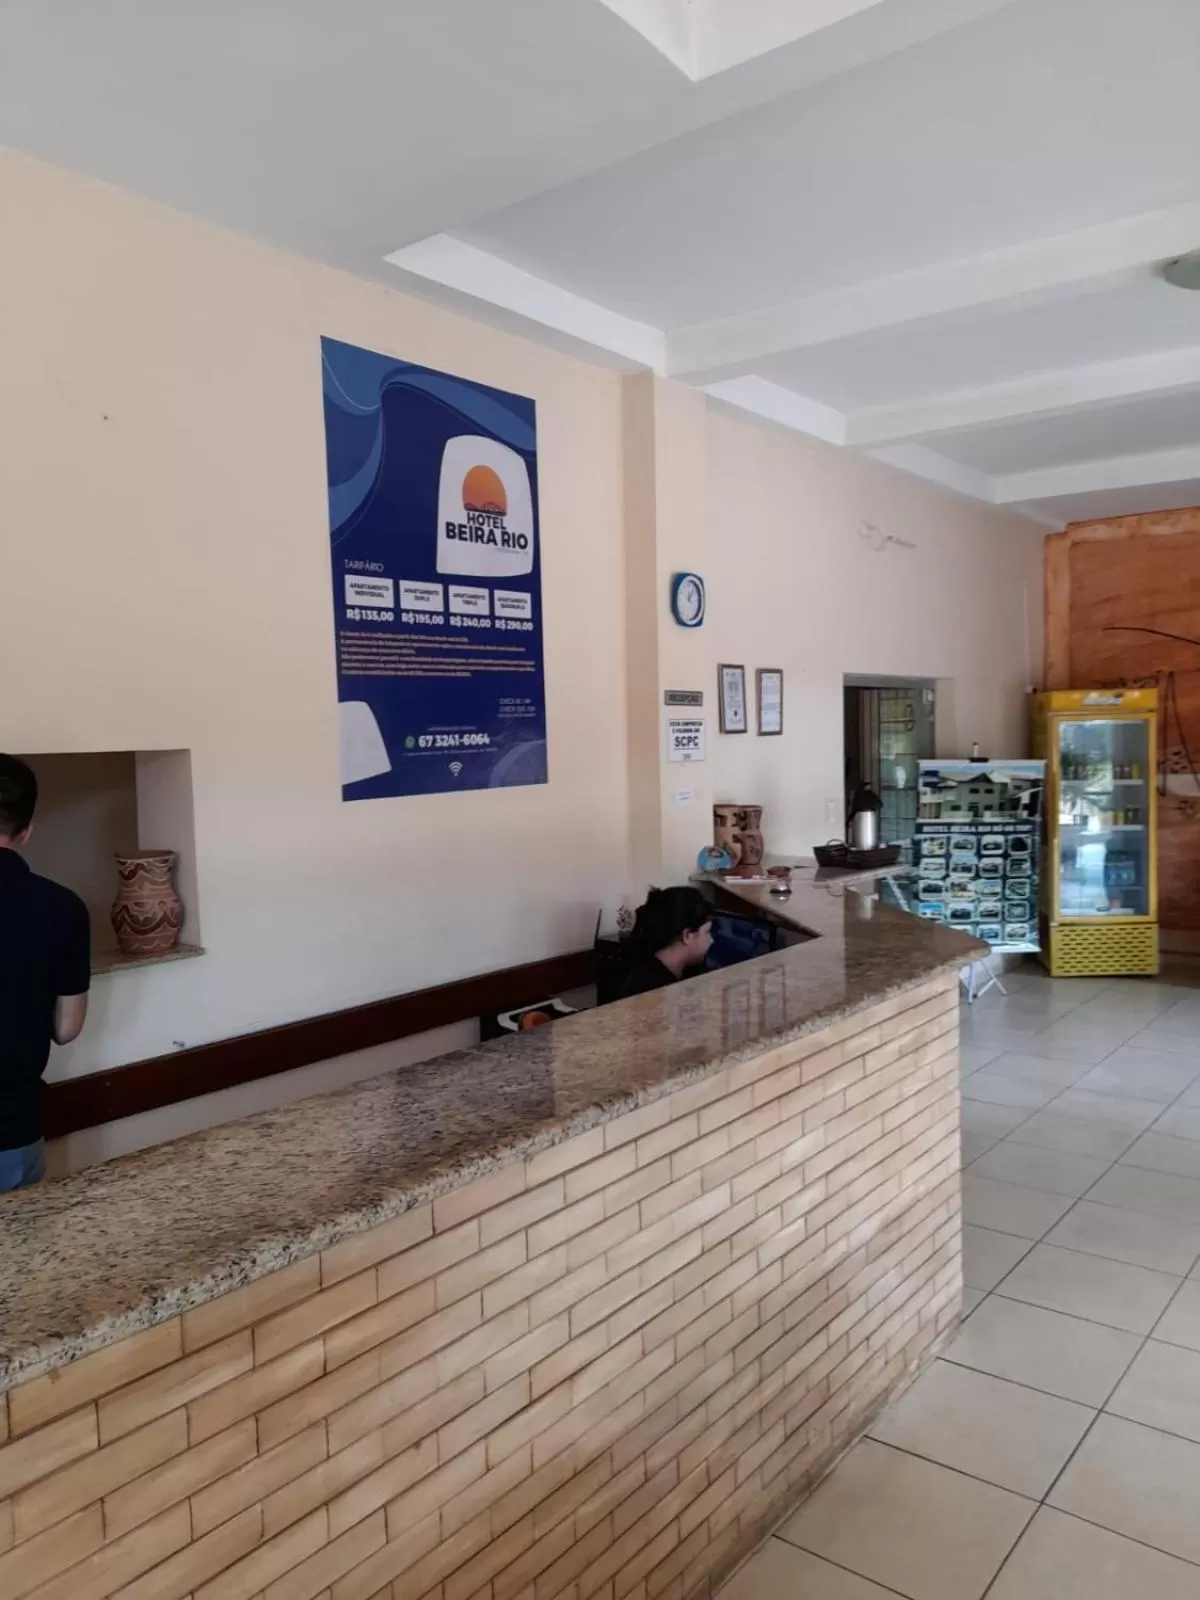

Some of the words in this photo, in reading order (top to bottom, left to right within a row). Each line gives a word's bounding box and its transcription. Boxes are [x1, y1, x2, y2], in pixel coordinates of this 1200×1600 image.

[466, 512, 507, 530] HOTEL
[445, 521, 498, 546] BEIRA
[501, 530, 528, 550] RIO
[344, 558, 384, 573] TARIFÁRIO
[418, 735, 433, 748] 67
[434, 733, 490, 746] 3241-6064
[674, 736, 699, 748] SCPC
